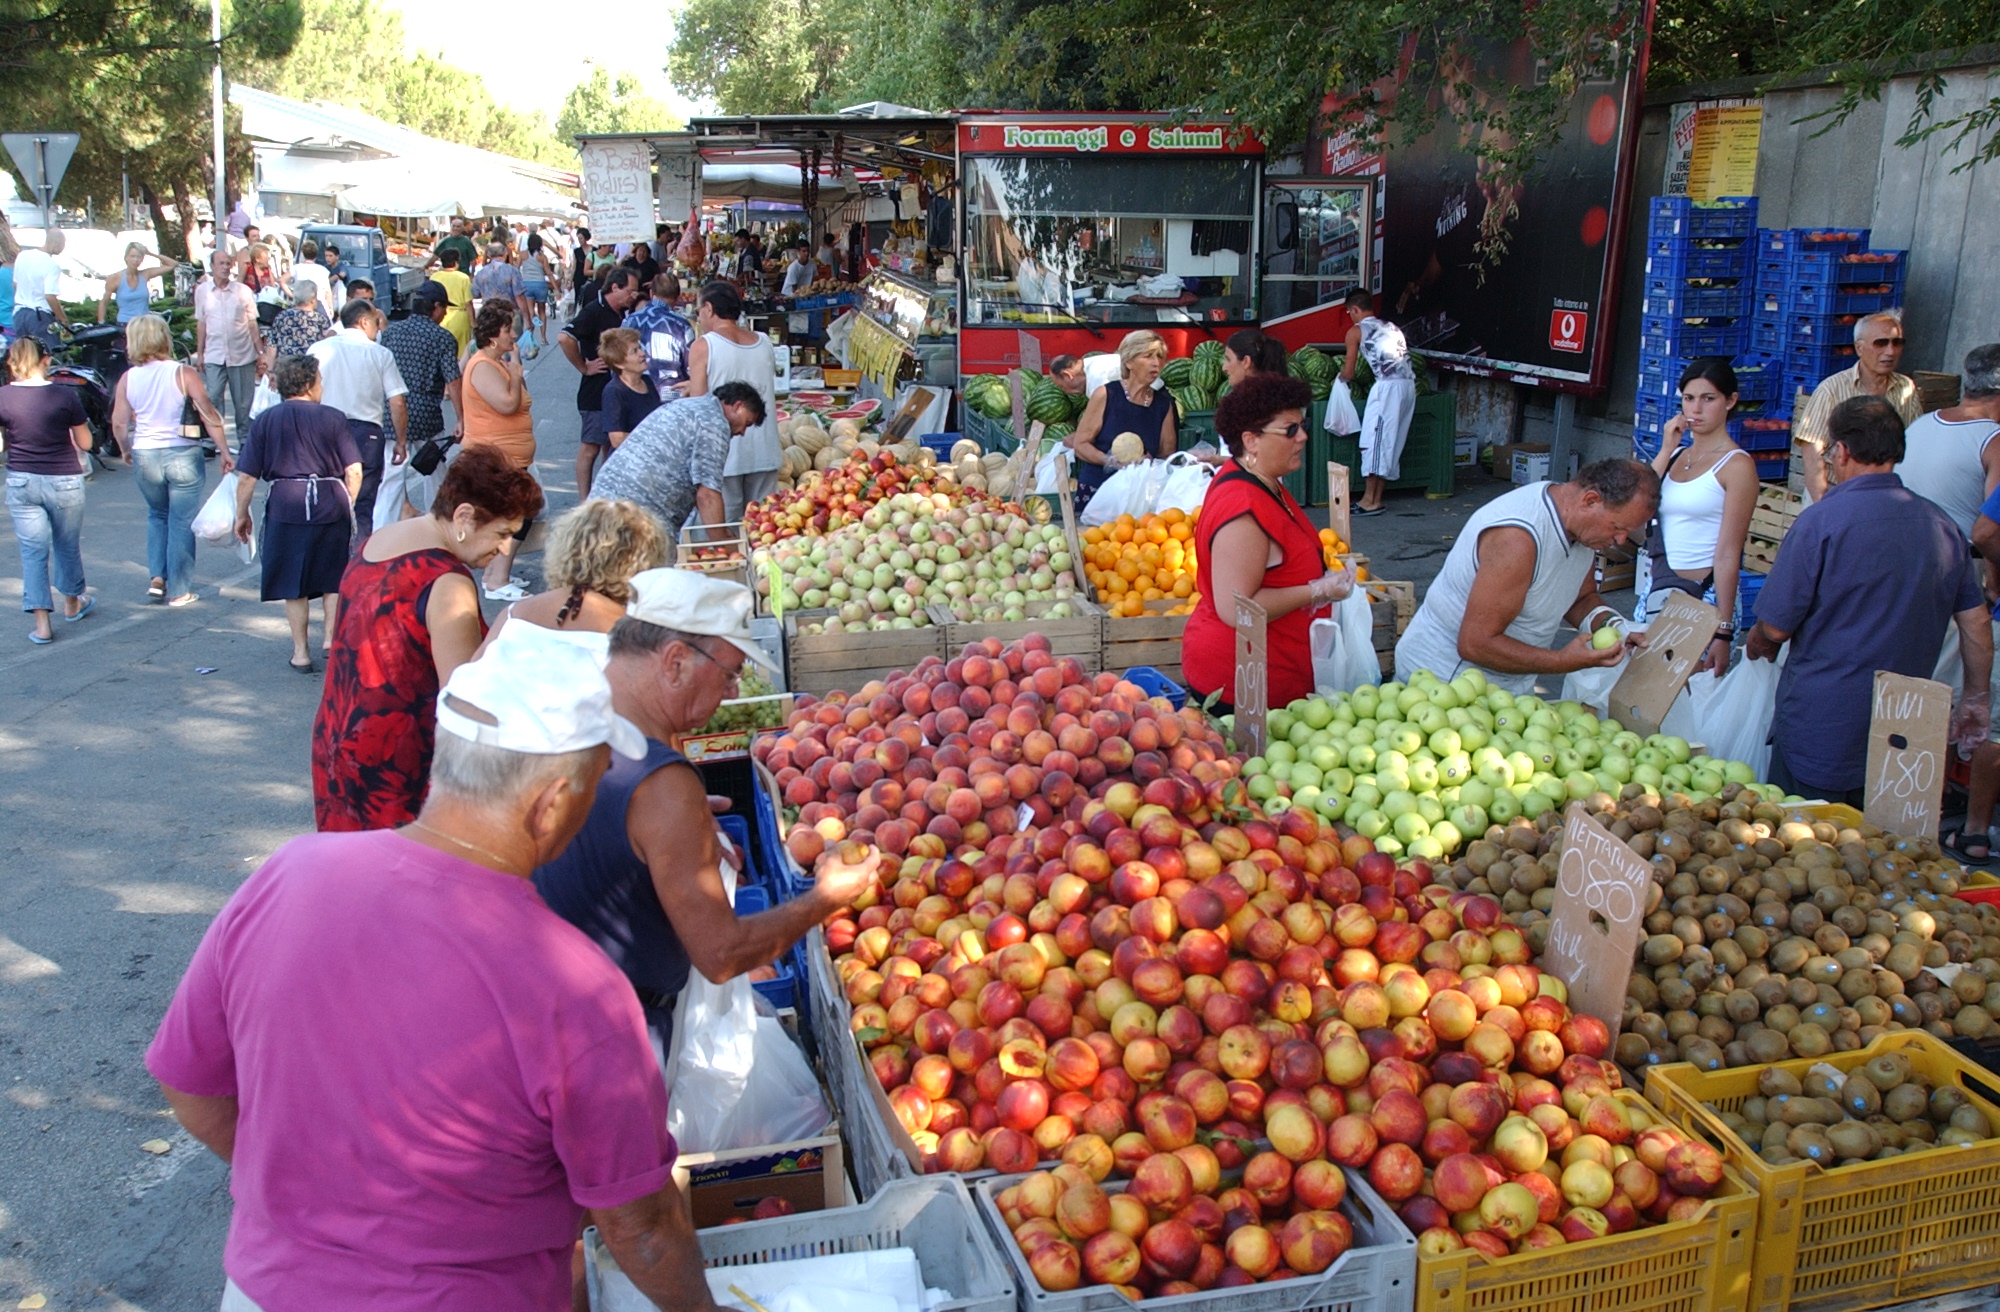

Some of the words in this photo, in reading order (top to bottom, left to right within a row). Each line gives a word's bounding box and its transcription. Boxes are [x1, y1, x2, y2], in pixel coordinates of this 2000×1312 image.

[1006, 127, 1107, 151] Formaggi
[1121, 130, 1135, 146] e
[1149, 128, 1222, 147] Salumi
[1559, 846, 1636, 924] 080
